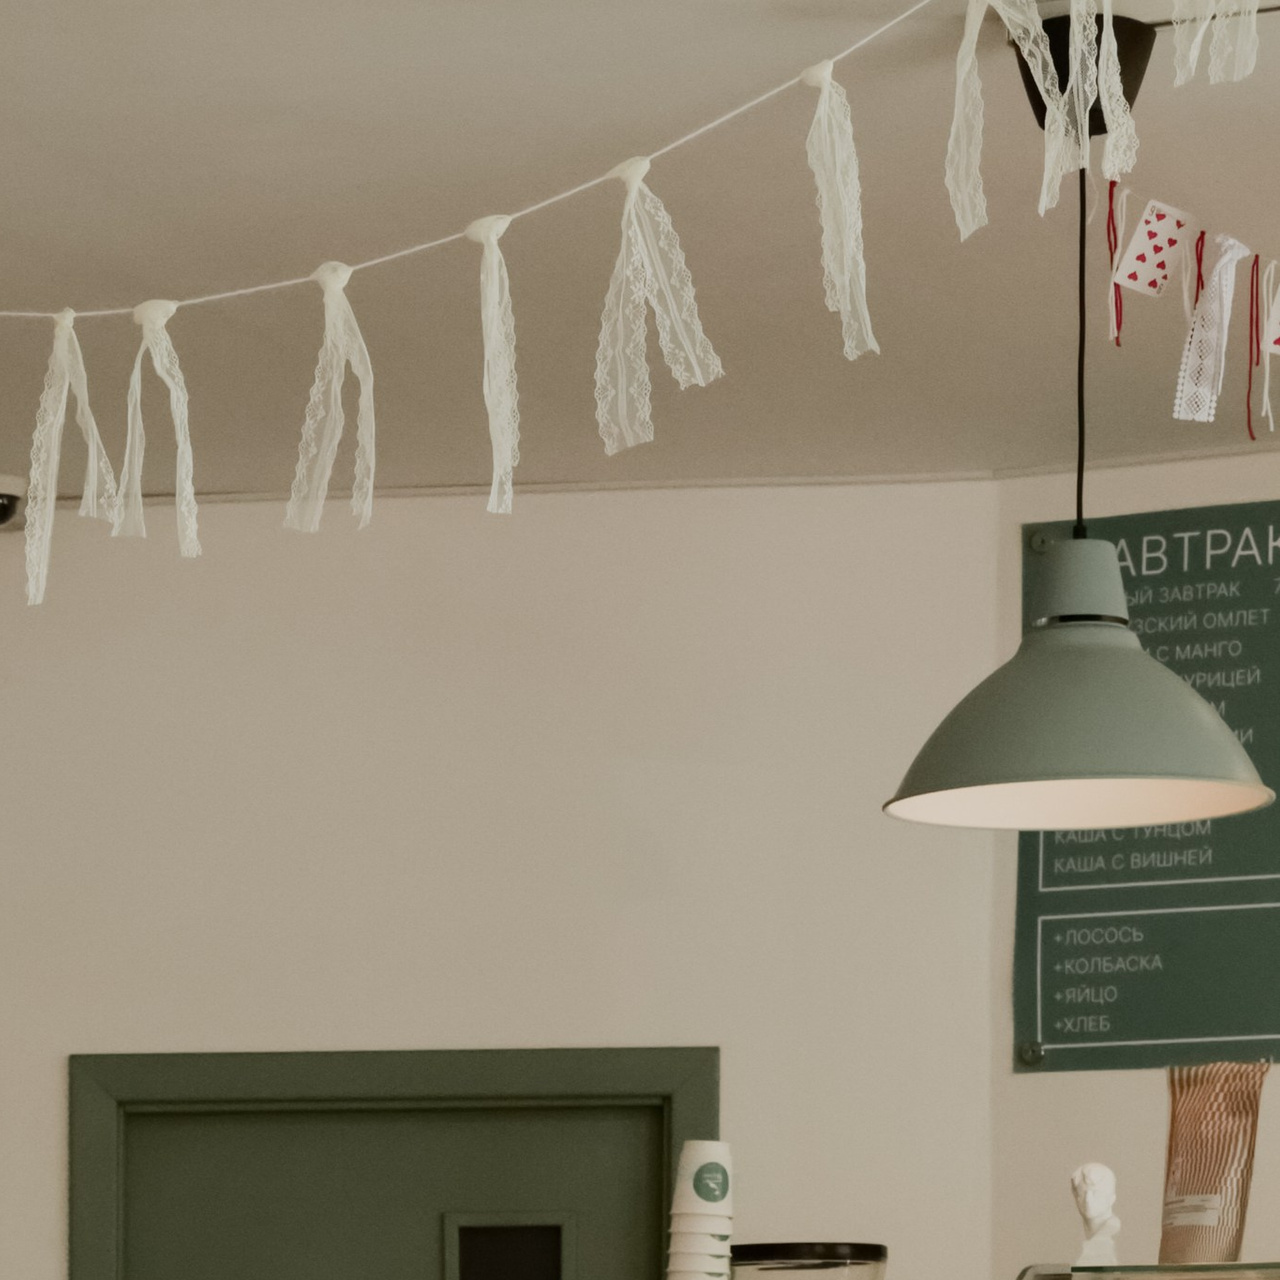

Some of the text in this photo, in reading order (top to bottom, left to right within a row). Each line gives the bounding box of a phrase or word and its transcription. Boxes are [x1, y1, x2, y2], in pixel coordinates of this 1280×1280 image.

[1159, 581, 1241, 604] ЗАВТРАК
[1203, 608, 1272, 630] ОМЛЕТ
[1156, 640, 1242, 662] С МАНГО
[1054, 845, 1213, 874] КАША С ВИШНЕЙ
